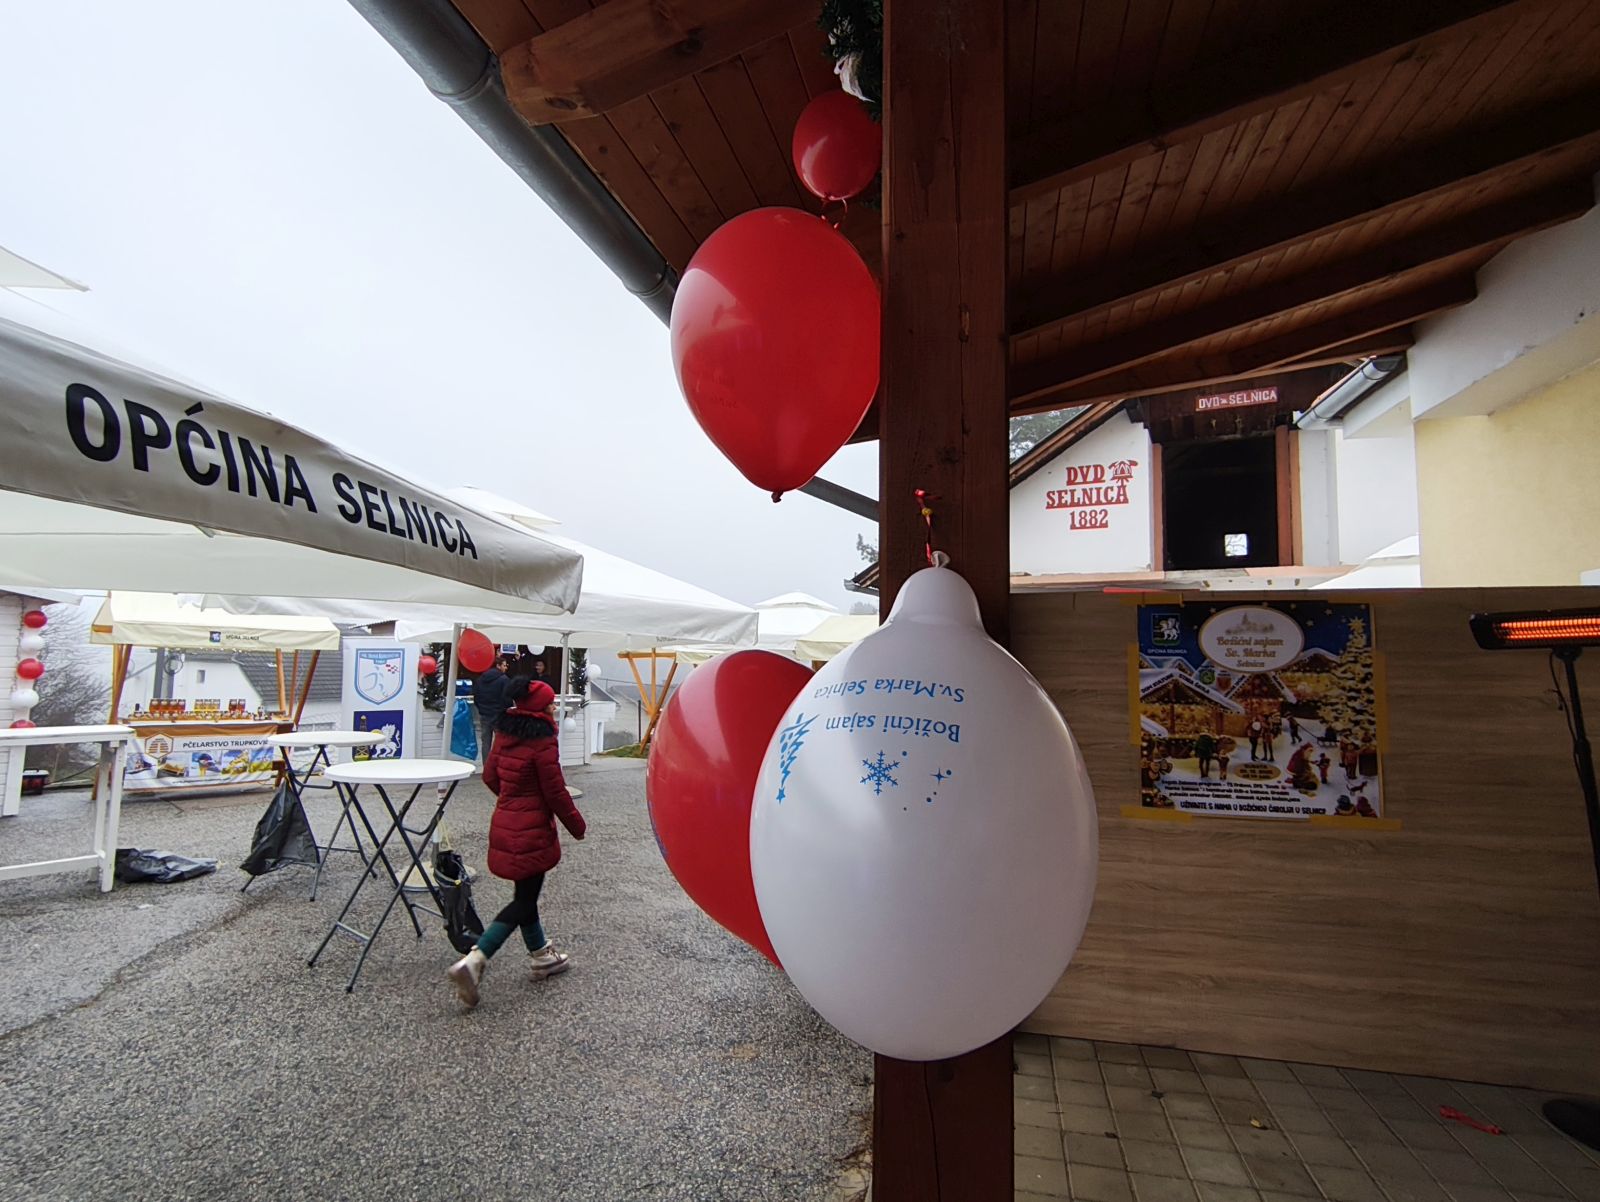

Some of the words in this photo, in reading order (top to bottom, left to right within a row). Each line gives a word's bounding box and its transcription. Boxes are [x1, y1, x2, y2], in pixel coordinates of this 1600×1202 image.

[1198, 397, 1219, 409] DVD
[1228, 390, 1278, 406] SELNICA
[65, 382, 318, 514] OPĆINA
[332, 472, 478, 560] SELNICA
[1066, 464, 1106, 485] DVD
[1046, 485, 1129, 508] SELNICA
[1070, 509, 1109, 529] 1882
[814, 680, 868, 699] Selnica
[874, 678, 965, 703] Sv.Marka
[825, 713, 876, 733] sajam
[883, 715, 961, 743] Božićni
[182, 740, 229, 749] PČELARSTVO
[1233, 803, 1238, 811] U
